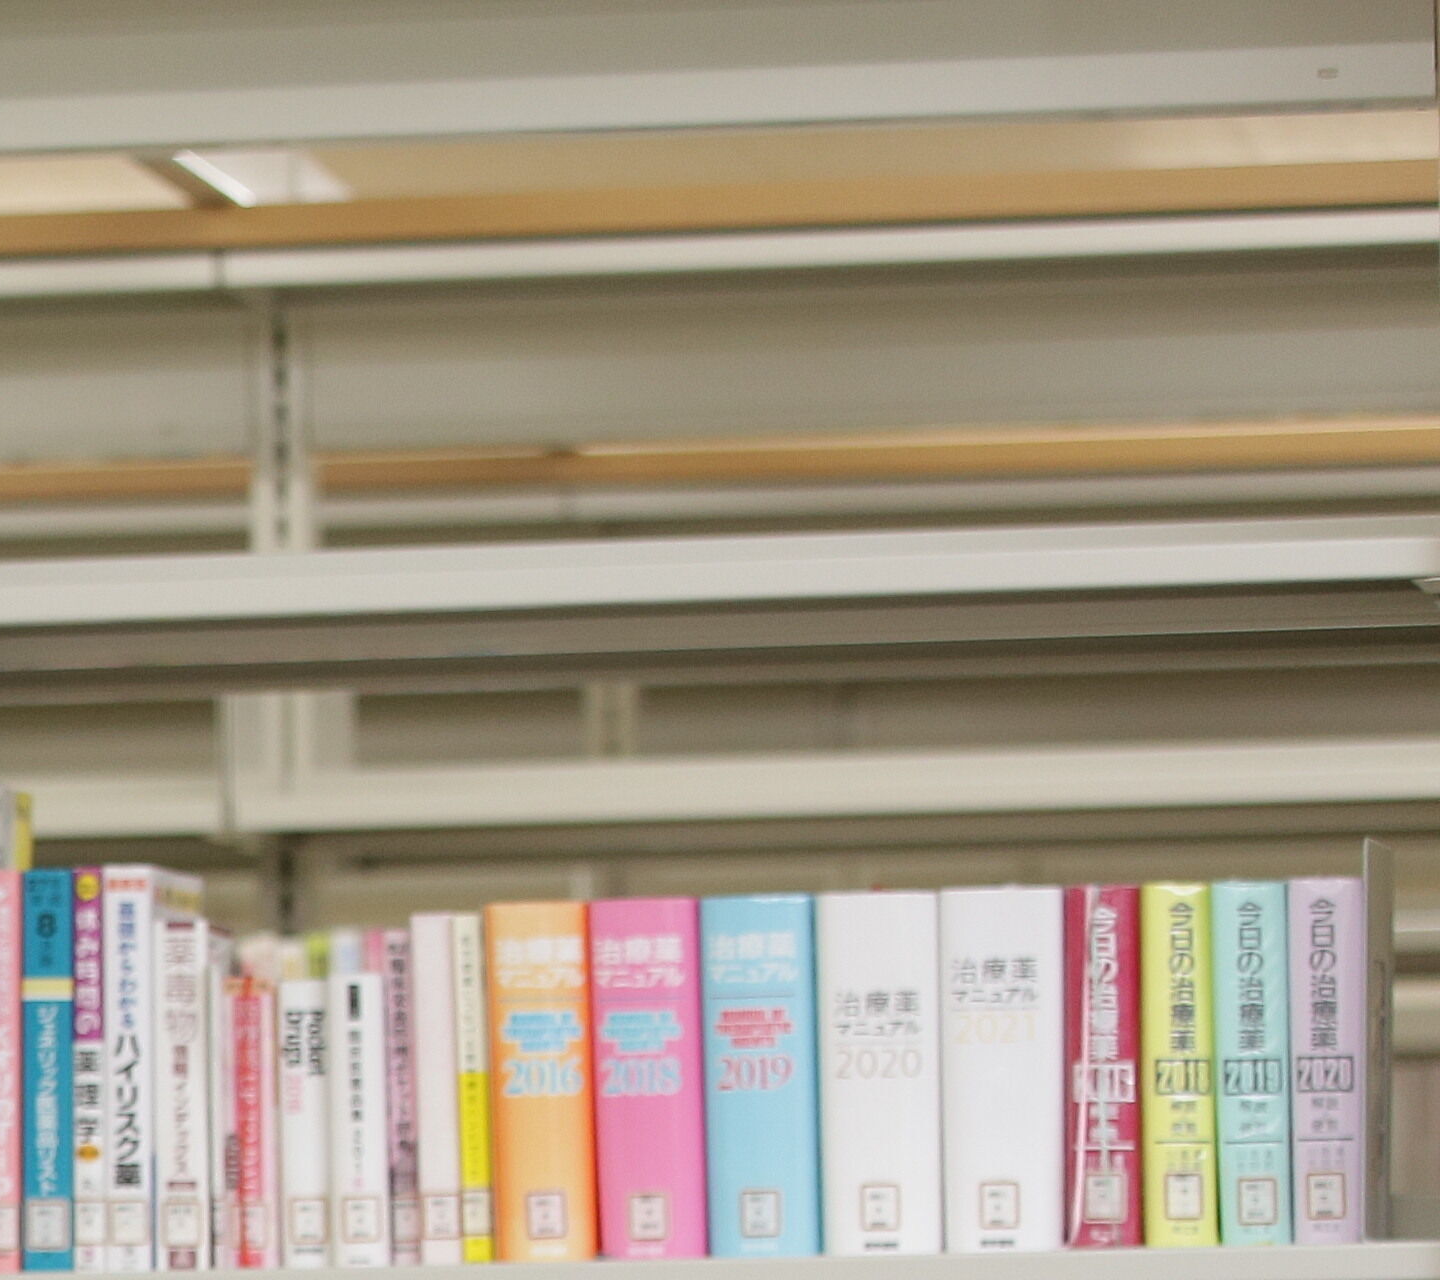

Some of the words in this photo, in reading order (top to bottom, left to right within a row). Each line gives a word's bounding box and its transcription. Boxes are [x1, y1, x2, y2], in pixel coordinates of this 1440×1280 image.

[951, 957, 1039, 984] 治療薬
[1167, 901, 1196, 1053] 今日の治療薬
[1235, 901, 1265, 1053] 今日の治療薬
[1308, 898, 1339, 1052] 今日の治療薬
[834, 991, 921, 1019] 治療薬
[951, 986, 1039, 1005] マニュアル
[835, 1018, 921, 1038] マニュアル
[504, 1058, 583, 1096] 2016
[716, 1053, 794, 1092] 2019
[835, 1048, 922, 1080] 2020
[1224, 1059, 1282, 1096] 2019
[1298, 1056, 1355, 1093] 2020
[114, 1034, 143, 1188] ハイリスク薬
